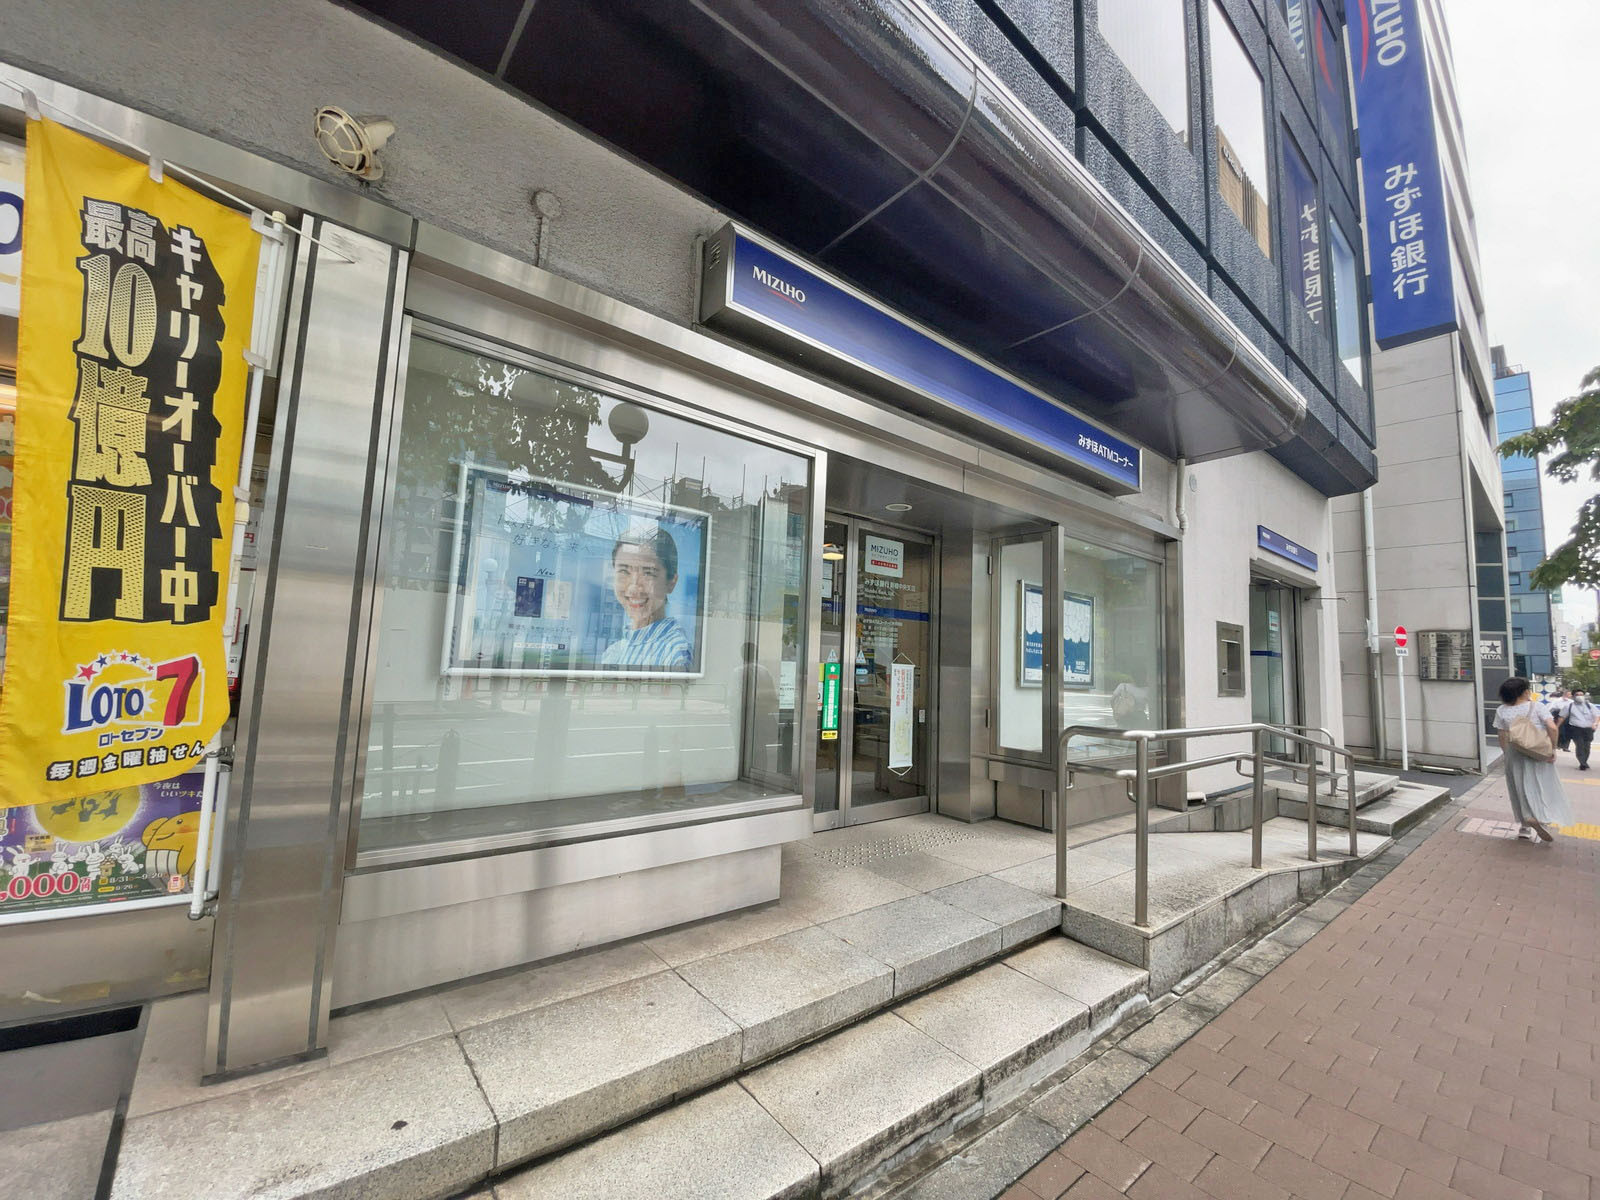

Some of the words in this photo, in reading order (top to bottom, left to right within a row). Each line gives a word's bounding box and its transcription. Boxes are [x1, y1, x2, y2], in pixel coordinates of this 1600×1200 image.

[84, 199, 157, 266] 最高
[1384, 162, 1429, 300] みずほ銀行
[752, 265, 806, 303] MIZUHO
[160, 225, 205, 623] キャリーオーバー中
[1078, 434, 1134, 467] みずほATMコーナー
[870, 544, 899, 557] MIZUHO
[66, 682, 144, 731] LOTO
[156, 656, 199, 726] 7
[98, 728, 164, 747] ロトセブン
[47, 740, 206, 781] 毎週金曜抽せん
